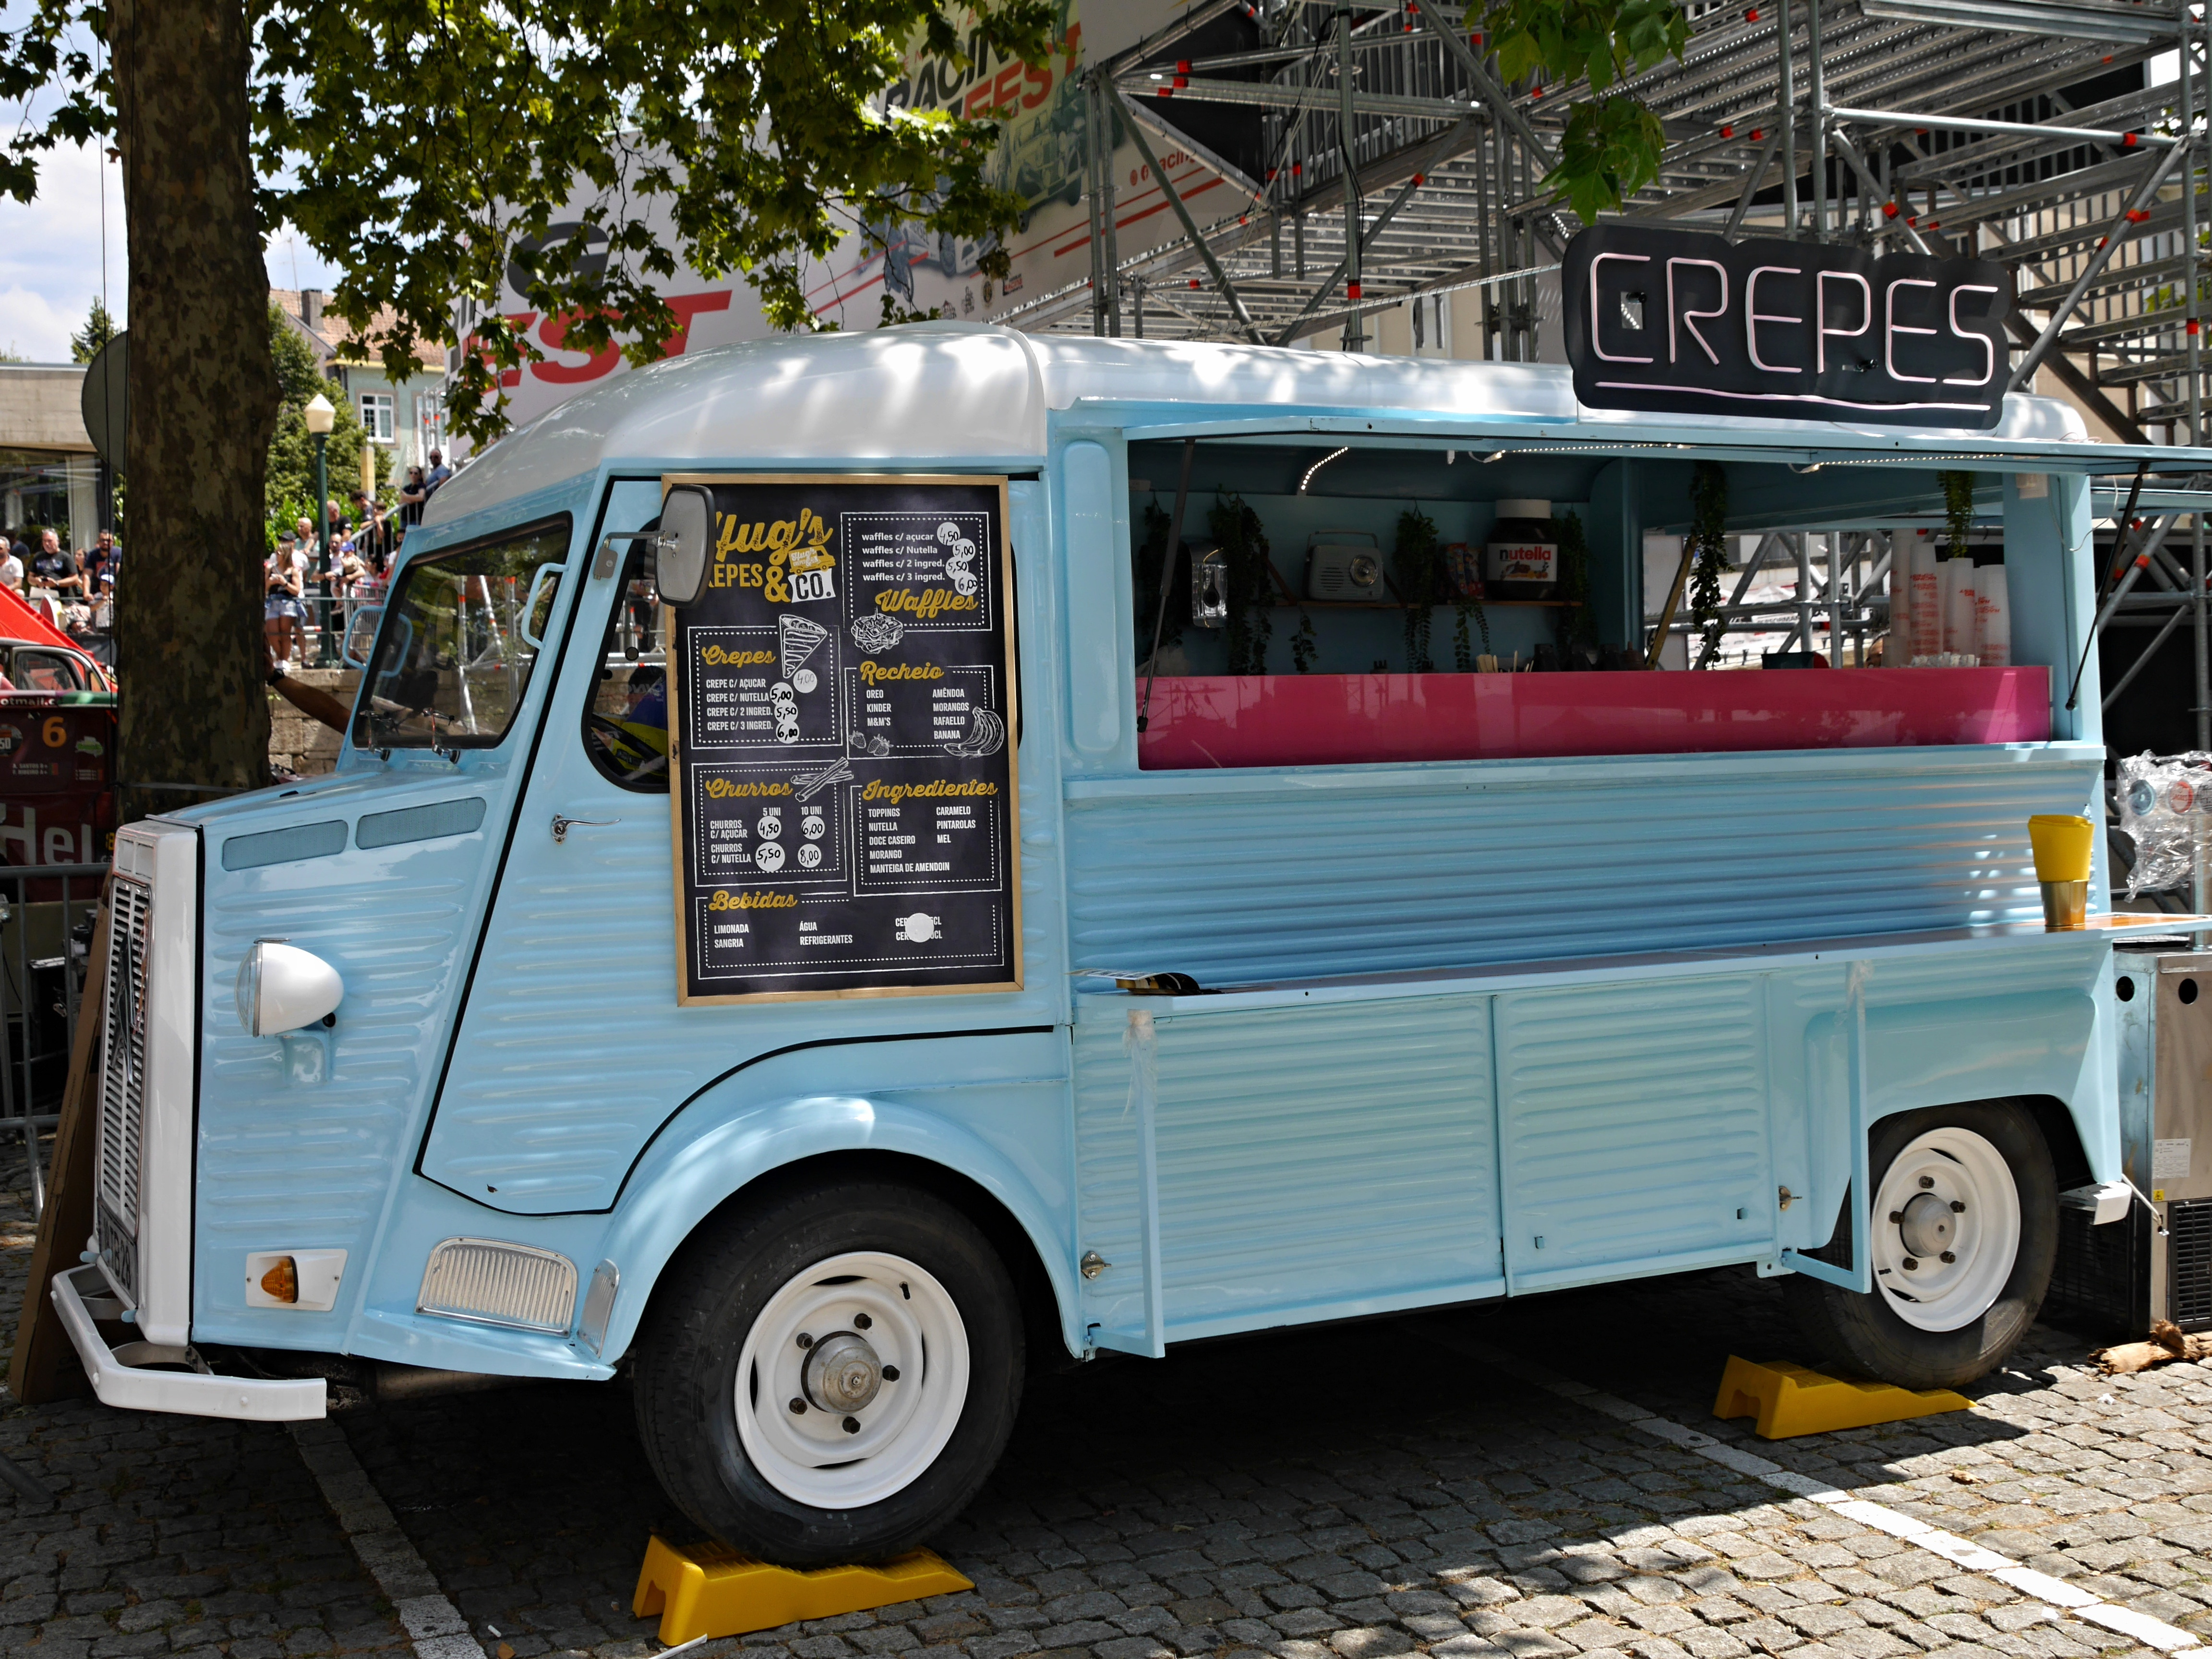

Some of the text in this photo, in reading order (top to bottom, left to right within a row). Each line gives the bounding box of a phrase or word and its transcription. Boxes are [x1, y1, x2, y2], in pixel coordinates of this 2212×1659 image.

[1590, 253, 1998, 385] CREPES
[895, 533, 904, 541] c/
[906, 533, 934, 542] açucar
[896, 546, 904, 554] c/
[955, 544, 974, 558] 5,00
[1499, 546, 1551, 561] nutella
[896, 560, 904, 568] c/
[914, 559, 945, 569] ingred.
[946, 561, 967, 574] 5,50
[897, 573, 905, 581] c/
[915, 573, 945, 582] ingred.
[764, 565, 792, 602] &
[795, 573, 832, 600] CO.
[875, 588, 979, 618] Waffles
[701, 645, 776, 668] Crepes
[860, 661, 945, 685] Recheio
[706, 679, 766, 690] CREPE C/ AÇUCAR
[707, 693, 769, 702] CREPE C/ NUTELLA
[770, 688, 792, 702] 5,00
[866, 689, 884, 698] OREO
[932, 687, 964, 698] AMÊNDOA
[707, 707, 773, 716] CREPE C/ 2 INGRED.
[866, 703, 891, 712] KINDER
[933, 702, 969, 712] MORANGOS
[776, 707, 797, 720] 5,50
[707, 721, 773, 731] CREPE C/ 3 INGRED.
[933, 716, 965, 726] RAFAELLO
[43, 717, 67, 747] 6
[777, 724, 798, 740] 6,00
[934, 730, 961, 739] BANANA
[705, 778, 793, 798] Churros
[862, 779, 998, 805] Ingredientes
[763, 807, 781, 816] 5 UNI
[801, 806, 822, 815] 10 UNI
[868, 808, 901, 817] TOPPINGS
[936, 806, 971, 816] CARAMELO
[710, 819, 742, 829] CHURROS
[801, 822, 823, 836] 6,00
[868, 822, 898, 831] NUTELLA
[937, 820, 976, 830] PINTAROLAS
[759, 822, 779, 837] 4,50
[710, 829, 747, 841] C/ AÇUCAR
[869, 835, 915, 845] DOCE CASEIRO
[937, 834, 951, 843] MEL
[711, 843, 743, 853] CHURROS
[711, 854, 751, 864] C/ NUTELLA
[757, 848, 781, 864] 5,50
[800, 849, 819, 866] 8,00
[869, 850, 902, 859] MORANGO
[870, 862, 950, 874] MANTEIGA DE AMENDOIN
[709, 890, 798, 911] Bebidas
[714, 924, 749, 934] LIMONADA
[799, 921, 817, 932] ÁGUA
[714, 938, 744, 948] SANGRIA
[800, 935, 853, 946] REFRIGERANTES
